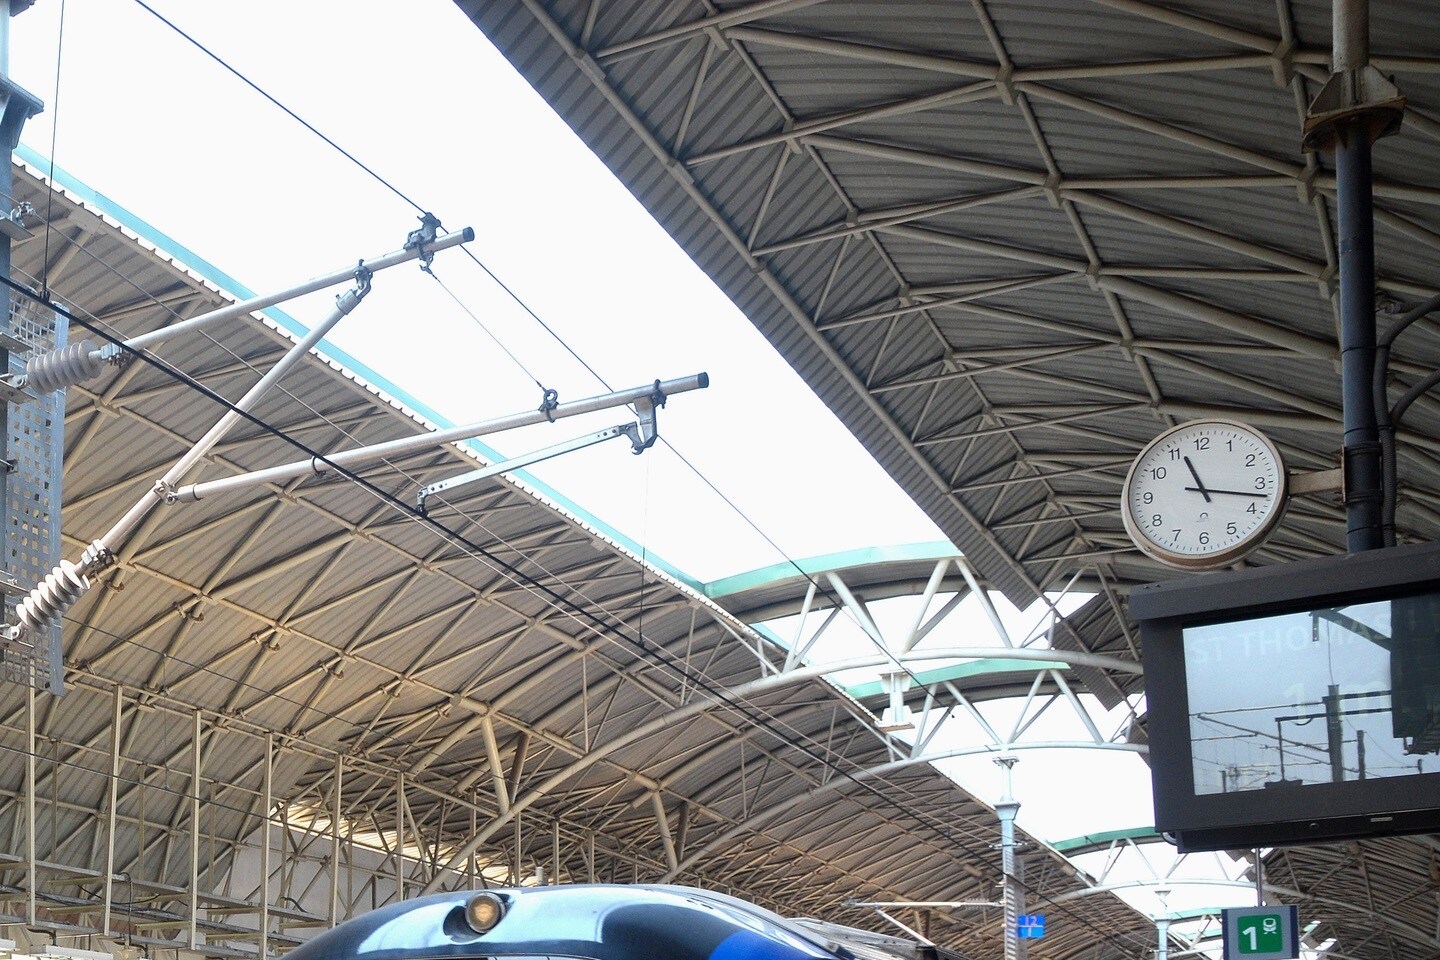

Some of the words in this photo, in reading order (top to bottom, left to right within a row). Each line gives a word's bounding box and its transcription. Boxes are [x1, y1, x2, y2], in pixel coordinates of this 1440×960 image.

[1193, 437, 1210, 451] 12
[1225, 440, 1233, 452] 1
[1168, 448, 1181, 461] 11
[1245, 454, 1256, 468] 2
[1150, 466, 1167, 480] 10
[1254, 477, 1266, 490] 3
[1143, 491, 1154, 505] 9
[1246, 502, 1258, 515] 4
[1152, 514, 1162, 527] 8
[1172, 529, 1182, 542] 7
[1226, 522, 1238, 535] 5
[1199, 531, 1210, 545] 6
[1189, 634, 1227, 665] ST
[1281, 682, 1307, 724] 1
[1240, 926, 1258, 951] 1
